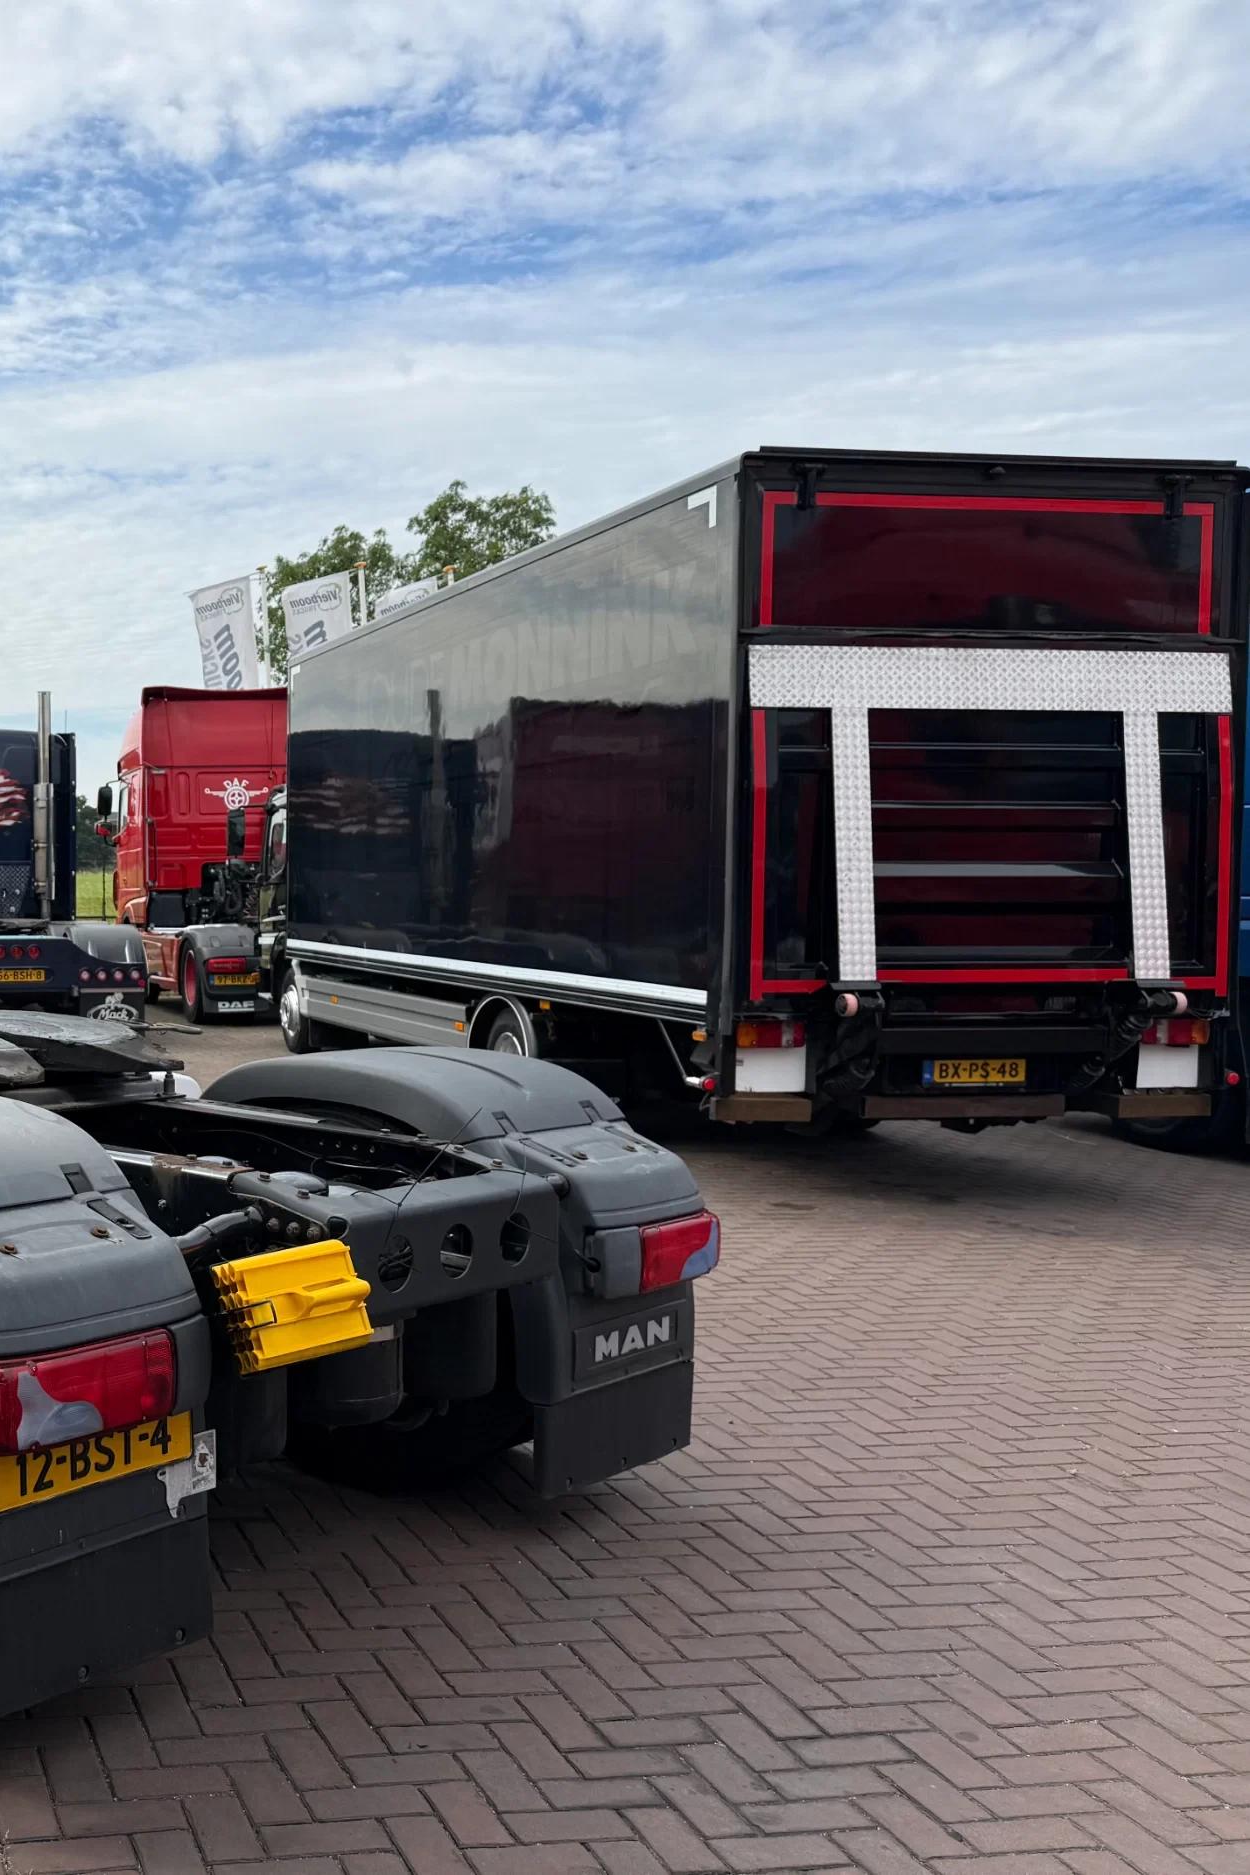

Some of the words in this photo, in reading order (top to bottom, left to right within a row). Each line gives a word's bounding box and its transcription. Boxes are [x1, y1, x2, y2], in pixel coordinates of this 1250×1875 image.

[222, 777, 250, 788] DAF
[217, 1000, 255, 1008] DAF
[99, 1009, 128, 1021] Mack
[939, 1062, 1019, 1079] BX-PS-48
[594, 1314, 671, 1363] MAN
[15, 1419, 172, 1497] 12-BST-4
